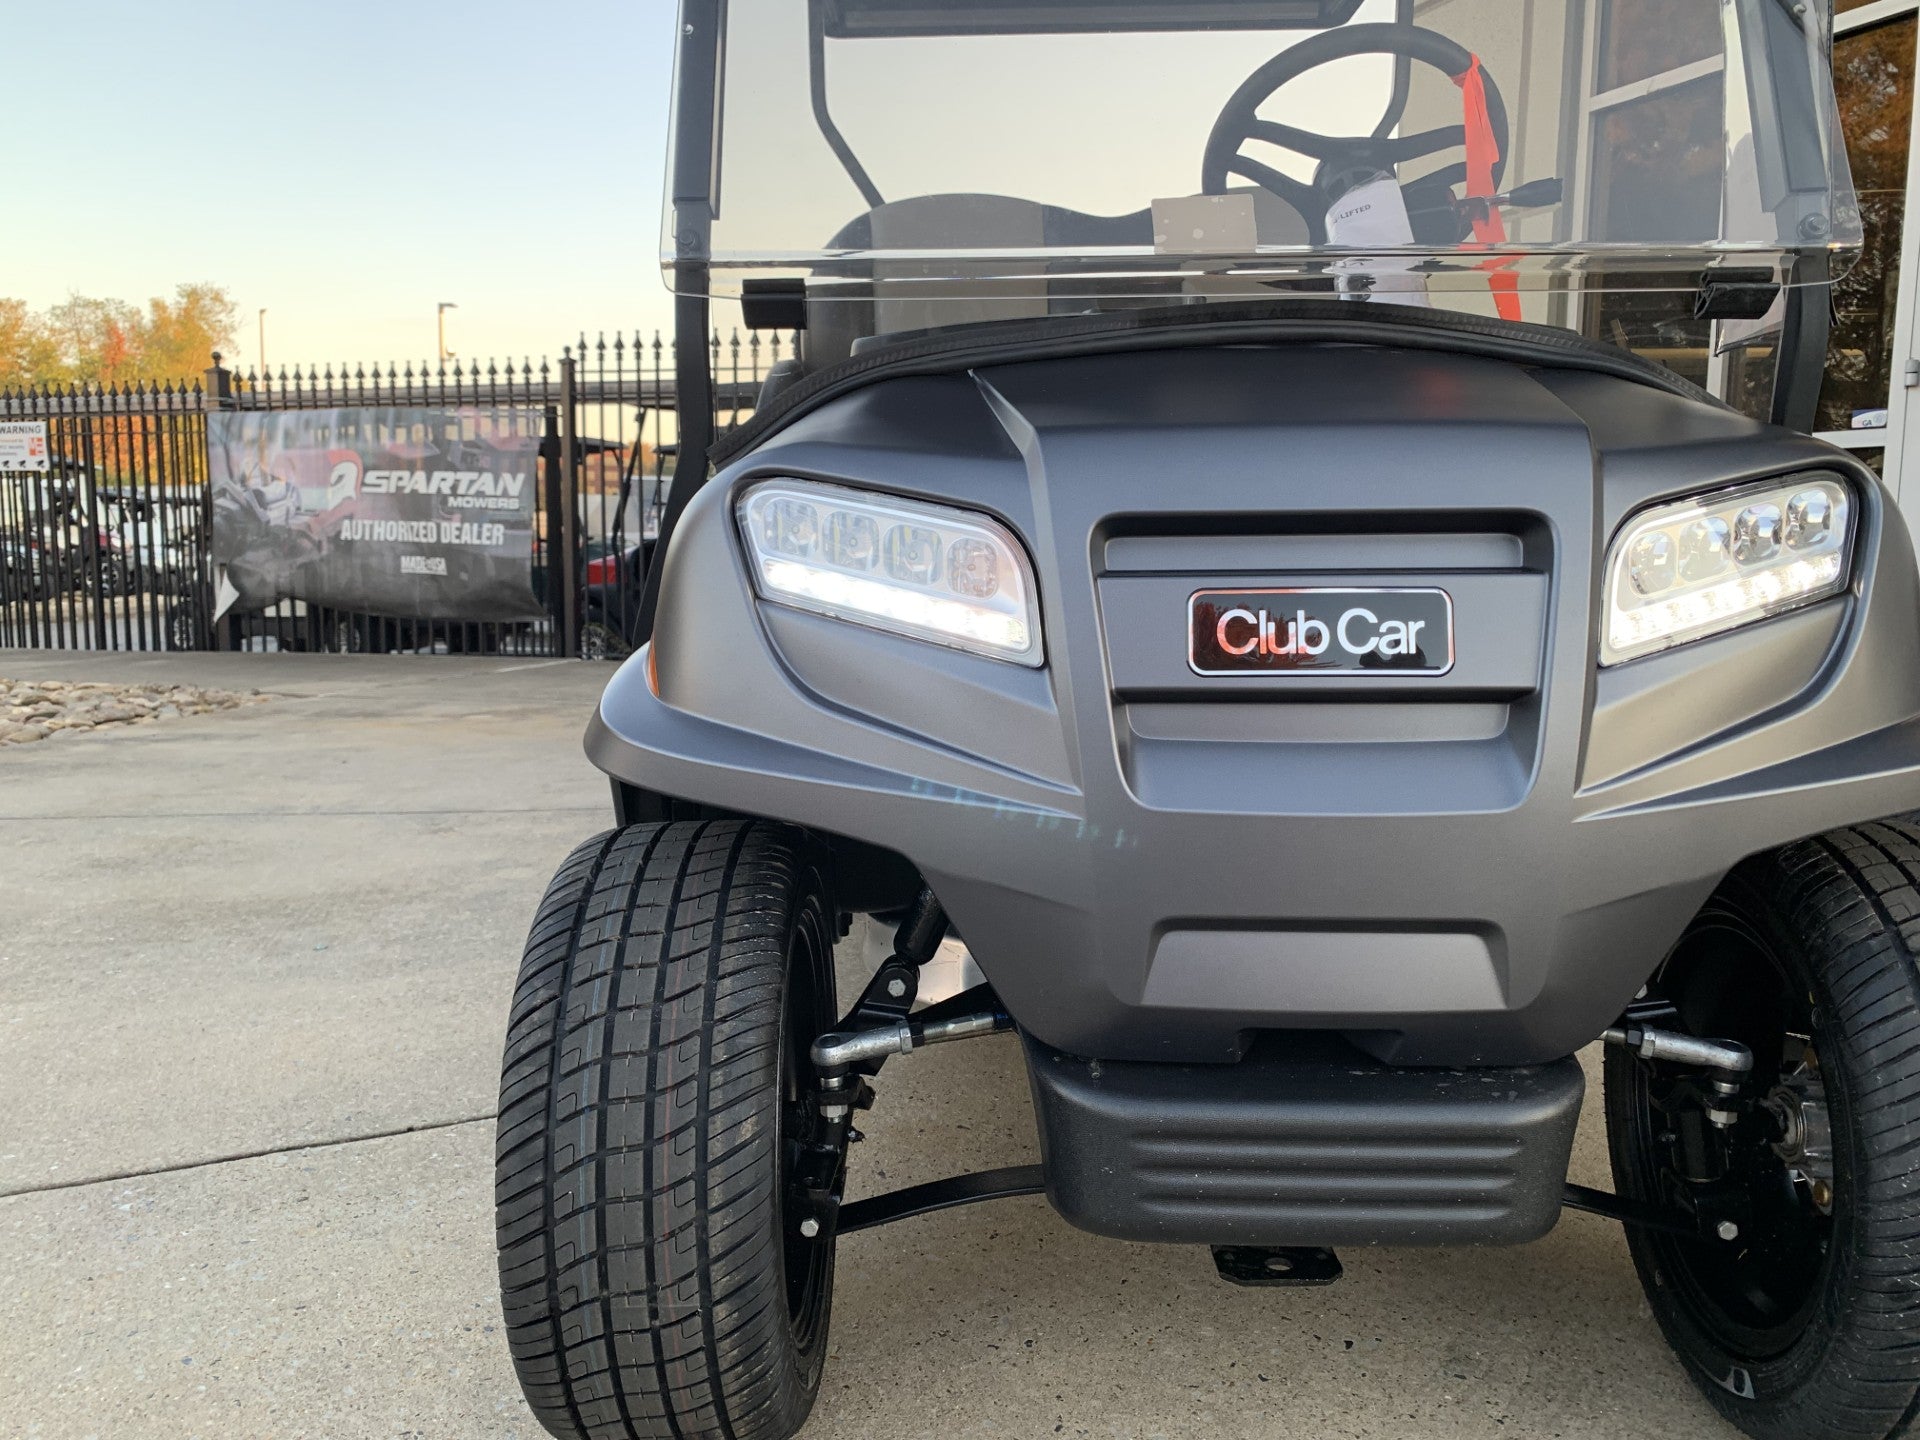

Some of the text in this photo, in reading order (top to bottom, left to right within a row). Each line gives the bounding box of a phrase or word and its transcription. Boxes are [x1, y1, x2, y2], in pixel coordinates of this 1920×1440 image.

[0, 425, 41, 434] WARNING
[361, 470, 525, 497] SPARTAN
[448, 496, 520, 510] MOWERS
[340, 519, 504, 545] AUTHORIZED DEALER
[1216, 607, 1425, 655] Club Car
